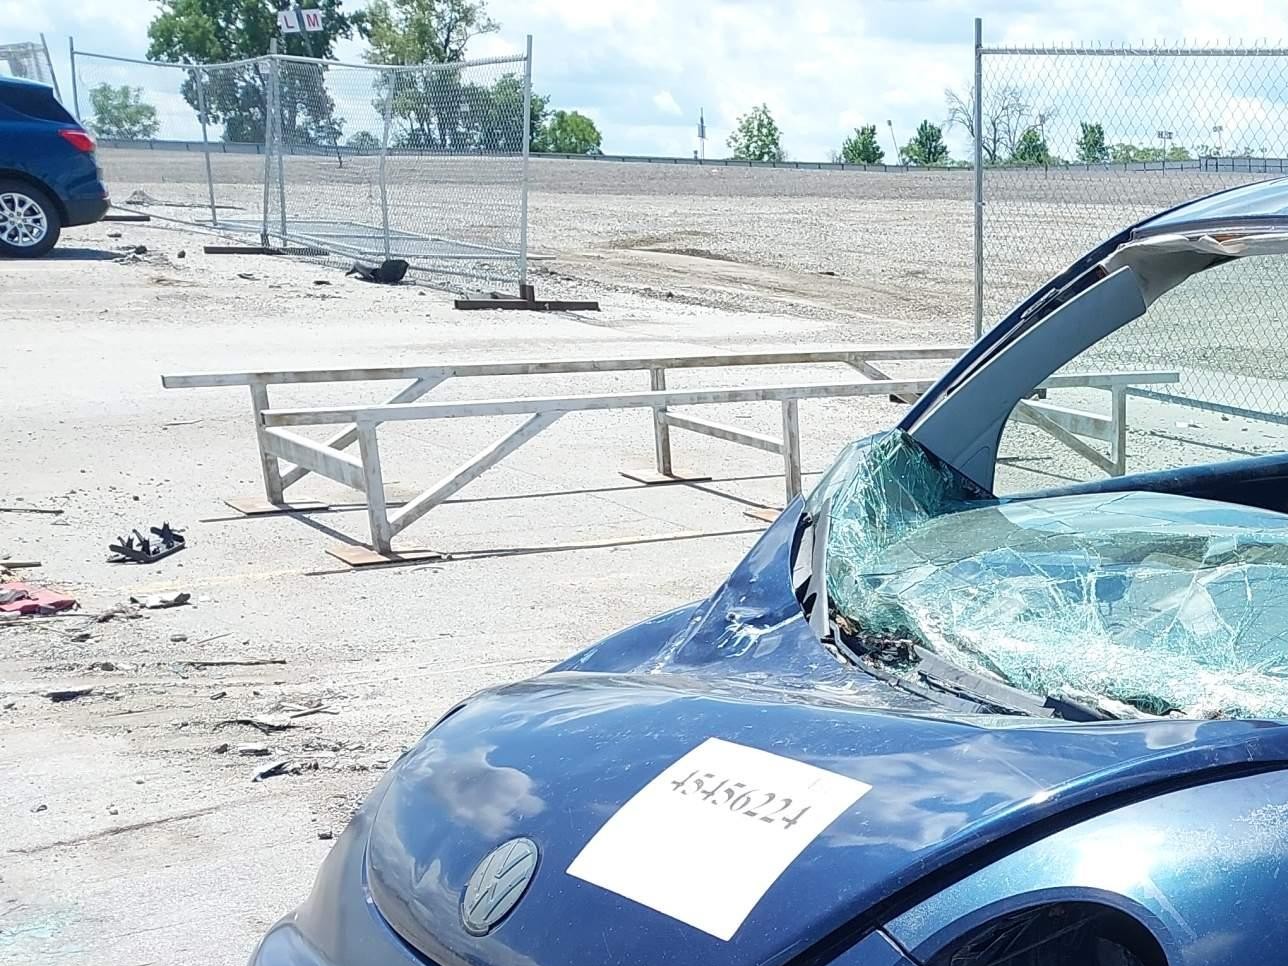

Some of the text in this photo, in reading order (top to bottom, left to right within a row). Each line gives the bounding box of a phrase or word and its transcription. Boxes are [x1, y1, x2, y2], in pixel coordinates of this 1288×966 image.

[283, 15, 295, 29] L
[306, 13, 320, 28] M
[669, 769, 811, 830] 45456224
